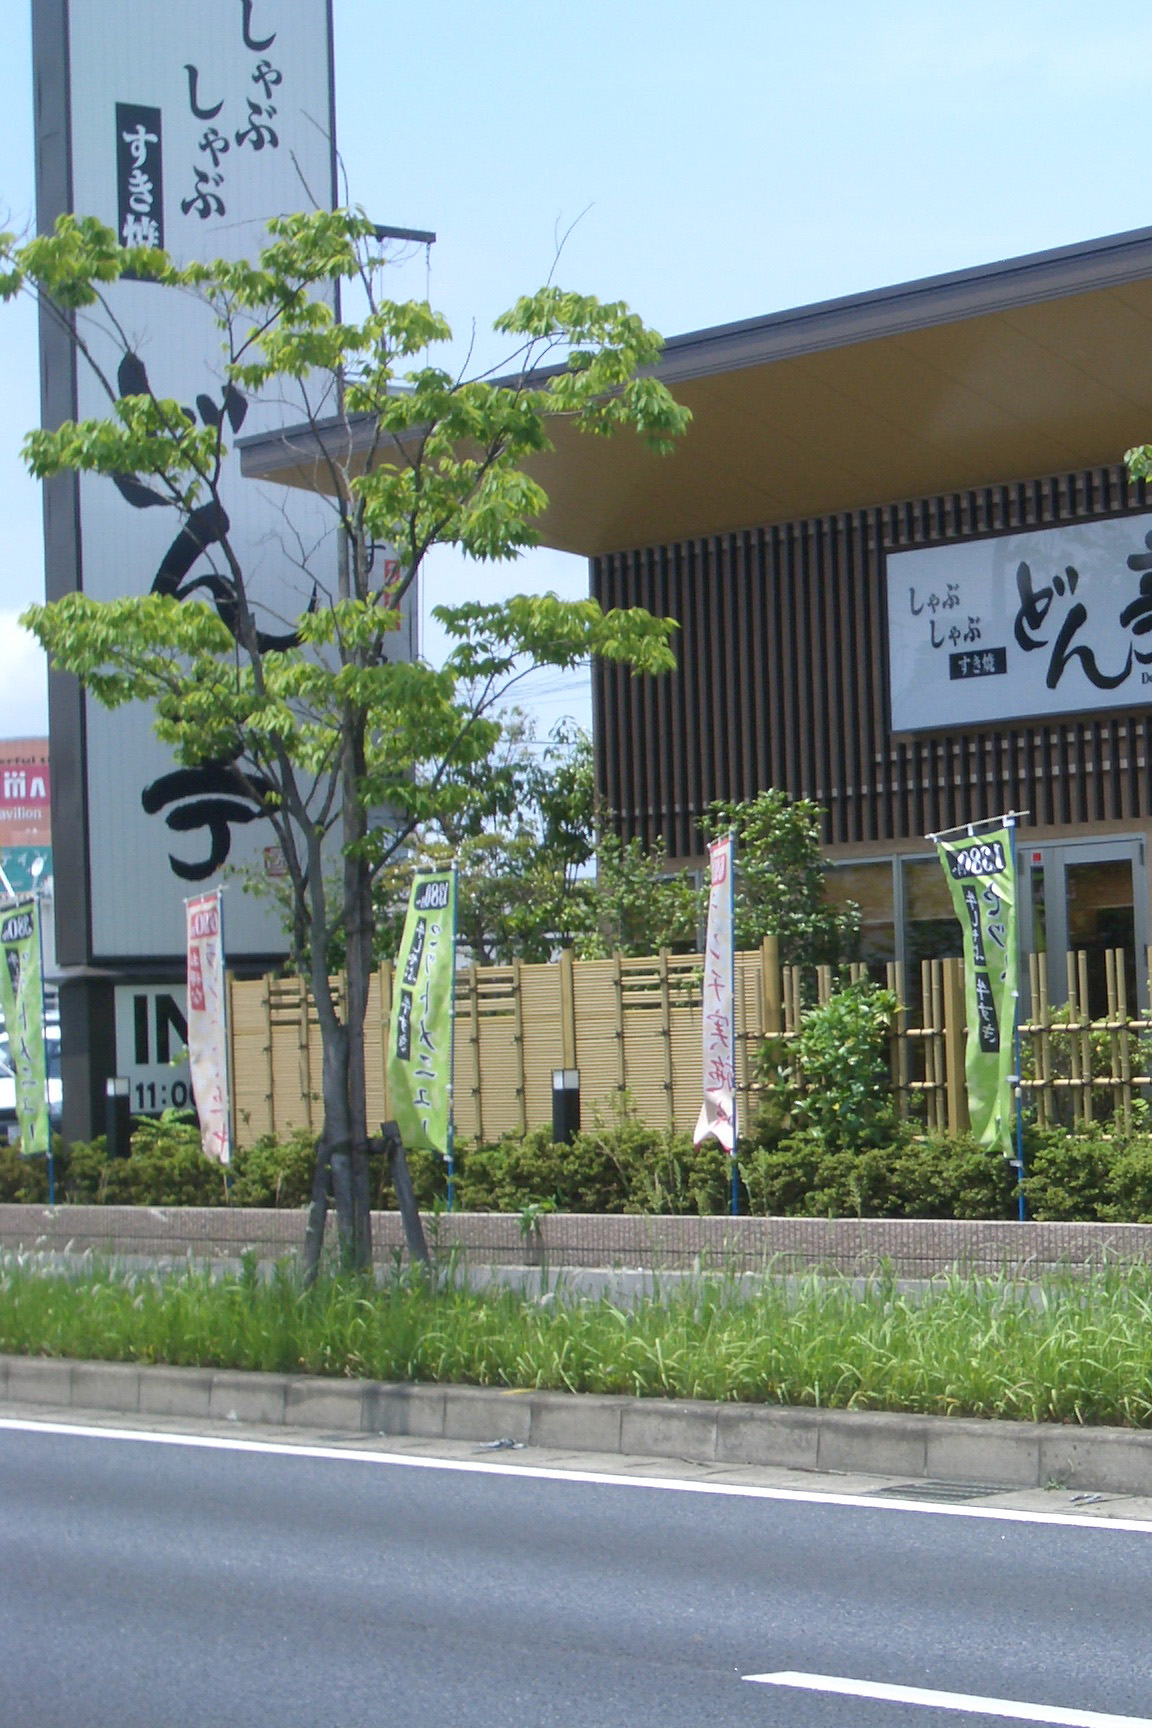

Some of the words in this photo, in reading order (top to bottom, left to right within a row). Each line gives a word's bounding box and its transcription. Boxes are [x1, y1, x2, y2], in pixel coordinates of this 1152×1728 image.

[235, 0, 282, 151] しゃぶ
[181, 64, 230, 219] しゃぶ
[909, 583, 960, 615] しゃぶ
[929, 616, 981, 648] しゃぶ
[958, 653, 996, 676] すき焼
[135, 1081, 197, 1110] 11:0
